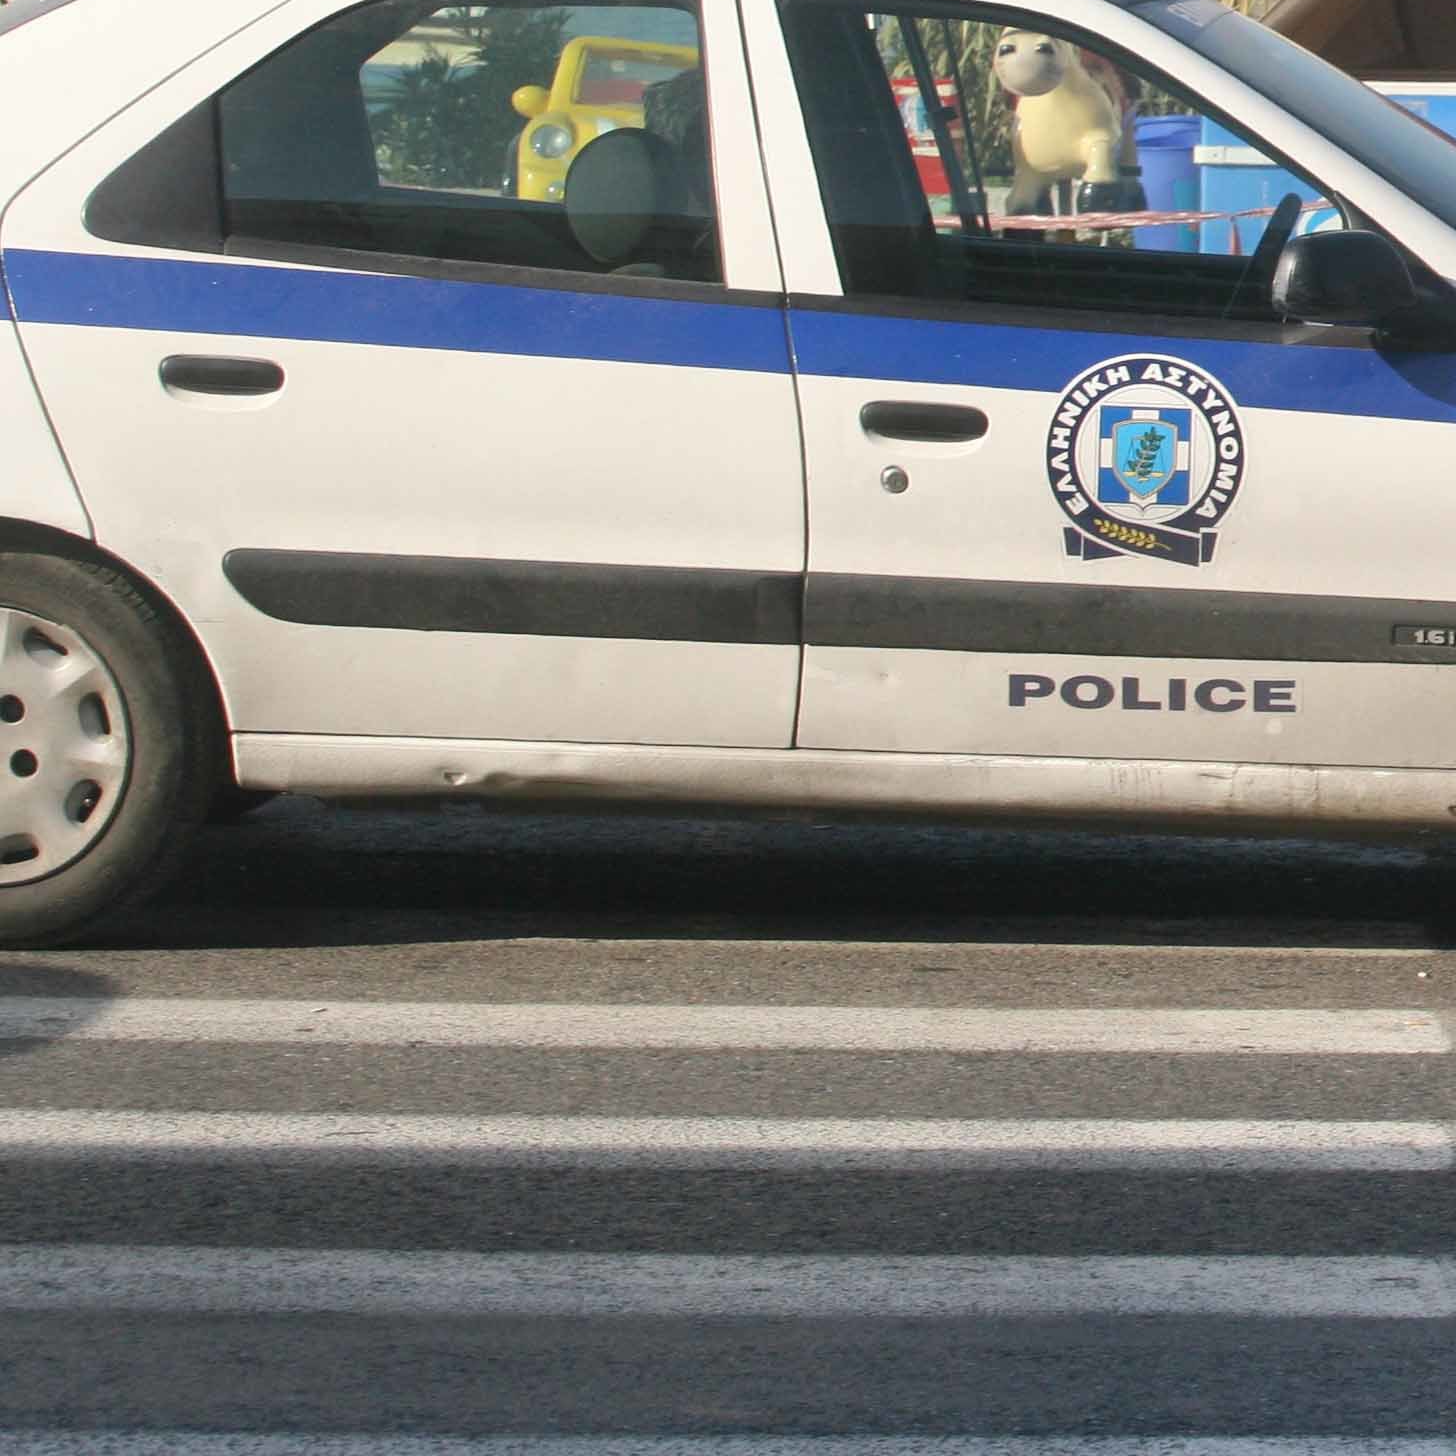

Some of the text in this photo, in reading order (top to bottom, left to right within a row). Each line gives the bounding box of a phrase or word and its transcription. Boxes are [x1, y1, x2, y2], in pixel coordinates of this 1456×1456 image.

[1050, 361, 1243, 520] ΕΛΛΗΝΙΚΗ ΑΣΤΥΝΟΜΙΑ
[1008, 672, 1298, 714] POLICE
